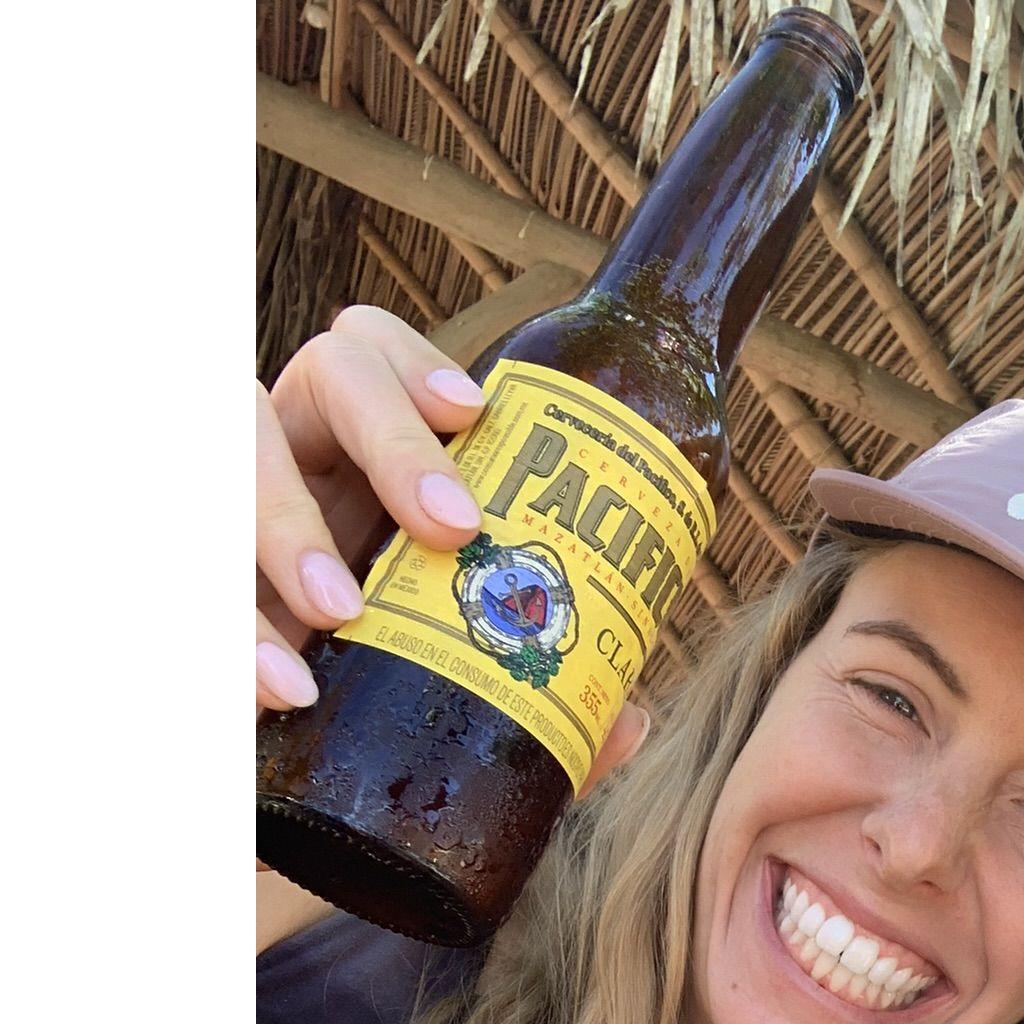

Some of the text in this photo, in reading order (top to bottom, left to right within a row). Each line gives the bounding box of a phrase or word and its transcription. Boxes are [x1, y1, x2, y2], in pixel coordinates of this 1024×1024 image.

[578, 448, 682, 548] CERVEZA
[616, 445, 640, 469] del
[375, 625, 389, 644] EL
[389, 631, 420, 656] ABUSO
[420, 641, 438, 662] EN
[435, 648, 450, 669] EL
[449, 656, 501, 697] CONSUMO
[496, 683, 515, 707] DE
[510, 694, 535, 721] ESTE
